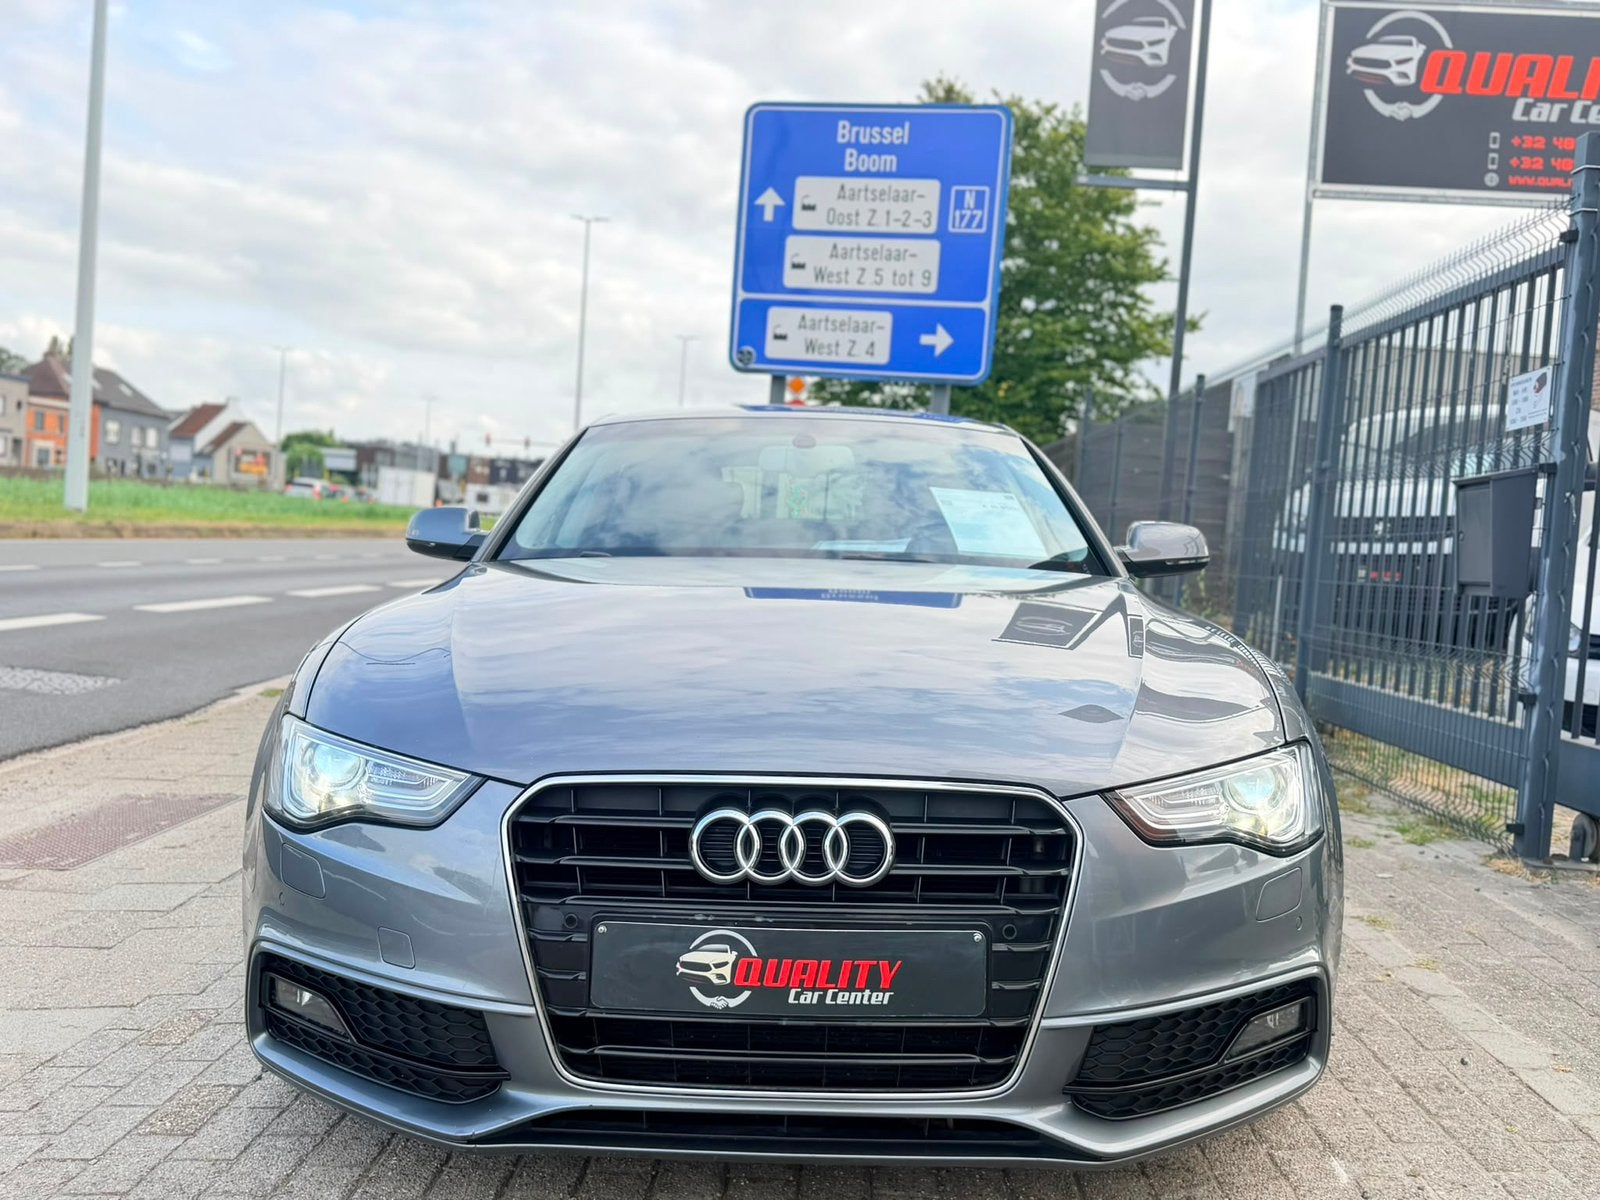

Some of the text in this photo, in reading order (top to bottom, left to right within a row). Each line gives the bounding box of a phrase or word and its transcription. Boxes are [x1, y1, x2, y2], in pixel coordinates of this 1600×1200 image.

[1512, 97, 1569, 123] Car
[837, 120, 910, 144] Brussel
[844, 148, 897, 173] Boom
[836, 183, 926, 204] Aartselaar-
[963, 190, 976, 209] N
[826, 208, 860, 227] Oost
[953, 210, 983, 229] 177
[829, 242, 918, 262] Aartselaar-
[813, 266, 850, 285] West
[892, 269, 915, 287] tot
[921, 269, 933, 287] 9
[798, 313, 885, 334] Aartselaar-
[804, 338, 840, 356] West
[733, 957, 902, 989] QUALITY
[788, 988, 894, 1005] Car Center
